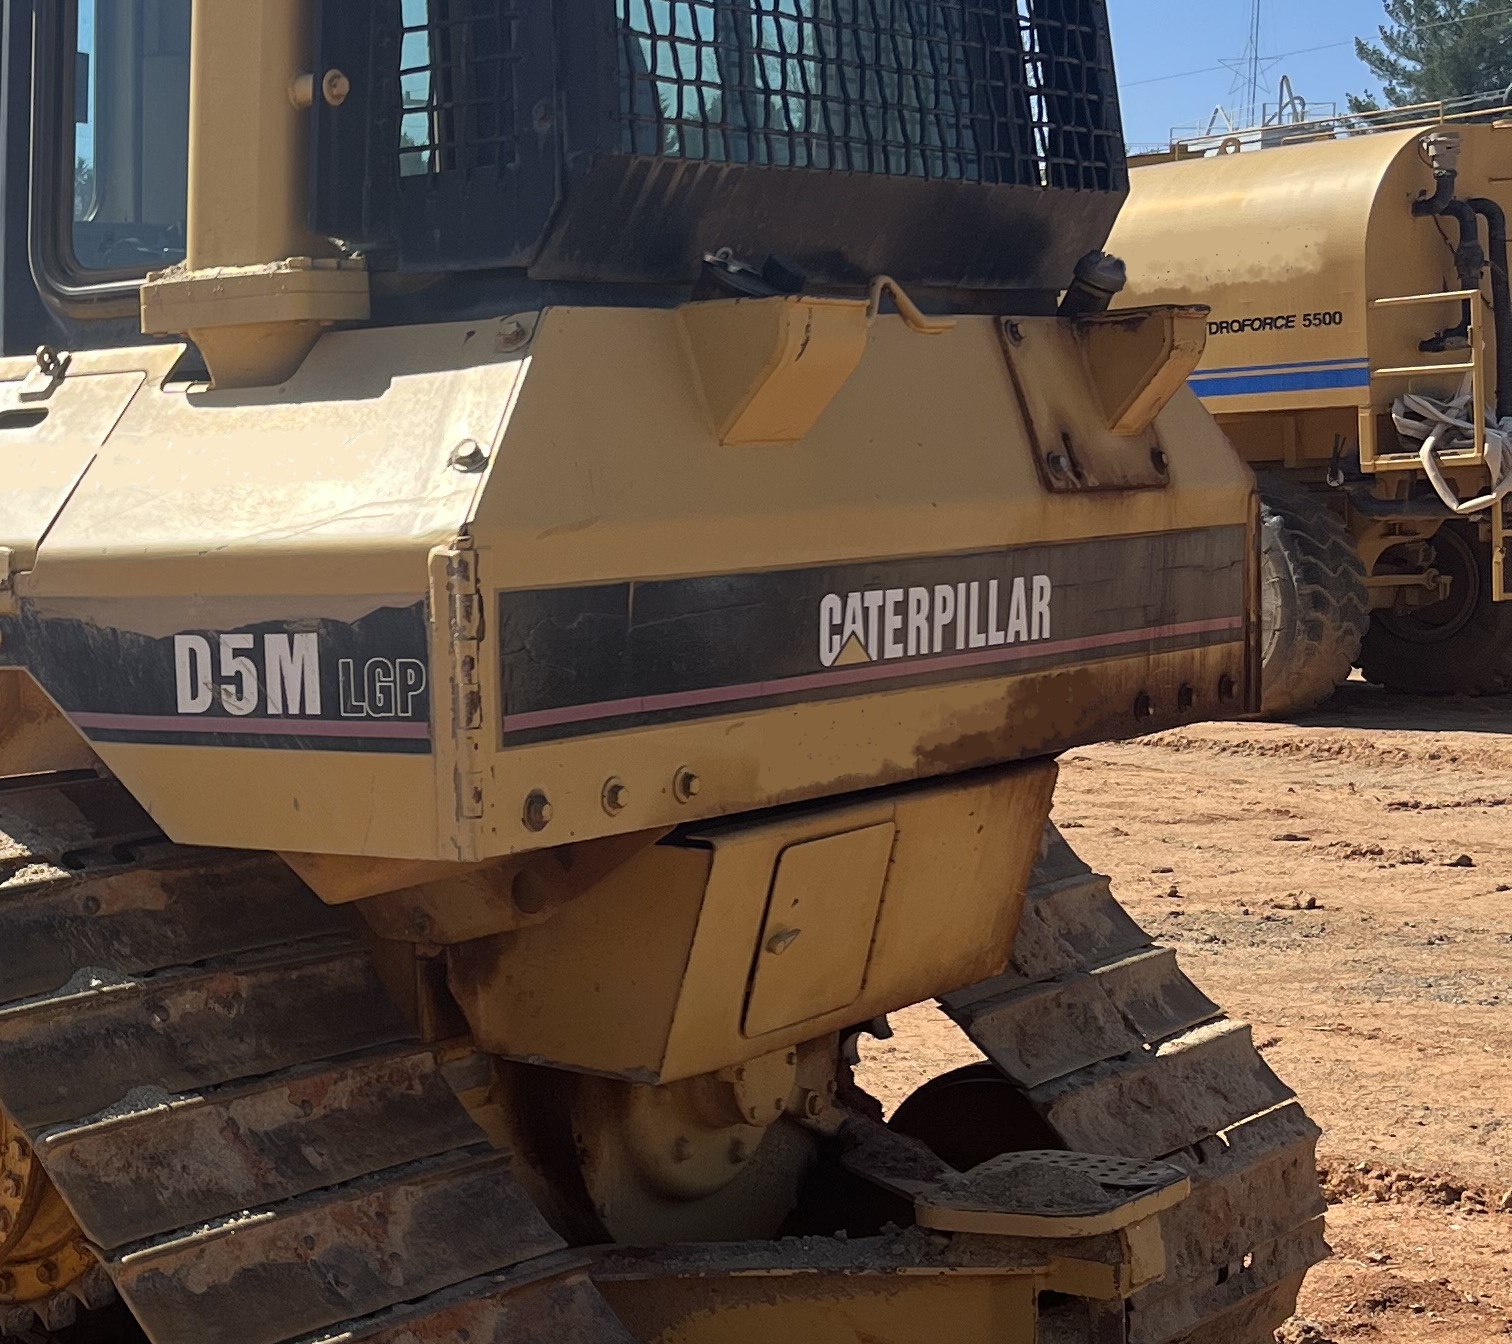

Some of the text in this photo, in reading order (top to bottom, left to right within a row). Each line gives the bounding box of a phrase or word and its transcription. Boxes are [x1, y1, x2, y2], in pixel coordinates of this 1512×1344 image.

[1206, 311, 1343, 336] DROFORCE 5500
[819, 574, 1053, 667] CATERPILLAR
[174, 632, 426, 718] D5M LGP
